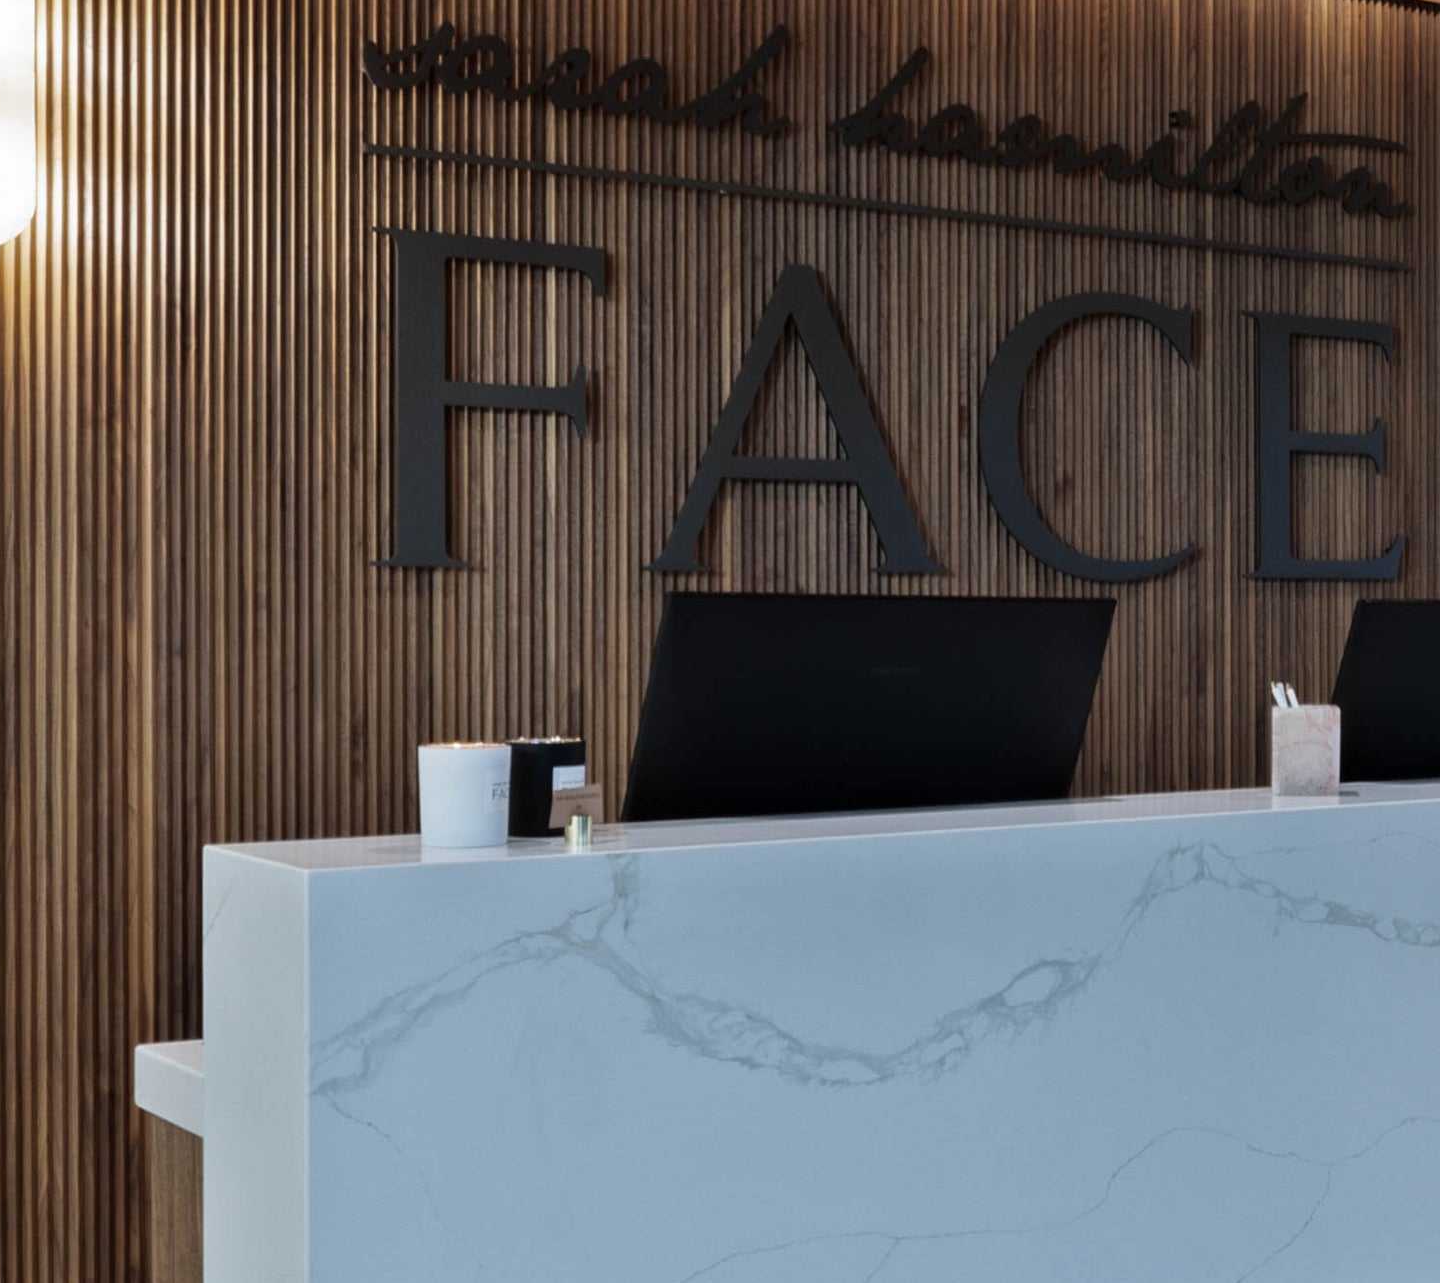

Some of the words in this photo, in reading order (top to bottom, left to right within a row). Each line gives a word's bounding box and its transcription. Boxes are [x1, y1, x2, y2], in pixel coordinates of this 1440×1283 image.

[363, 21, 791, 138] sarah
[830, 46, 1409, 218] hamilton
[370, 226, 1406, 584] FACE
